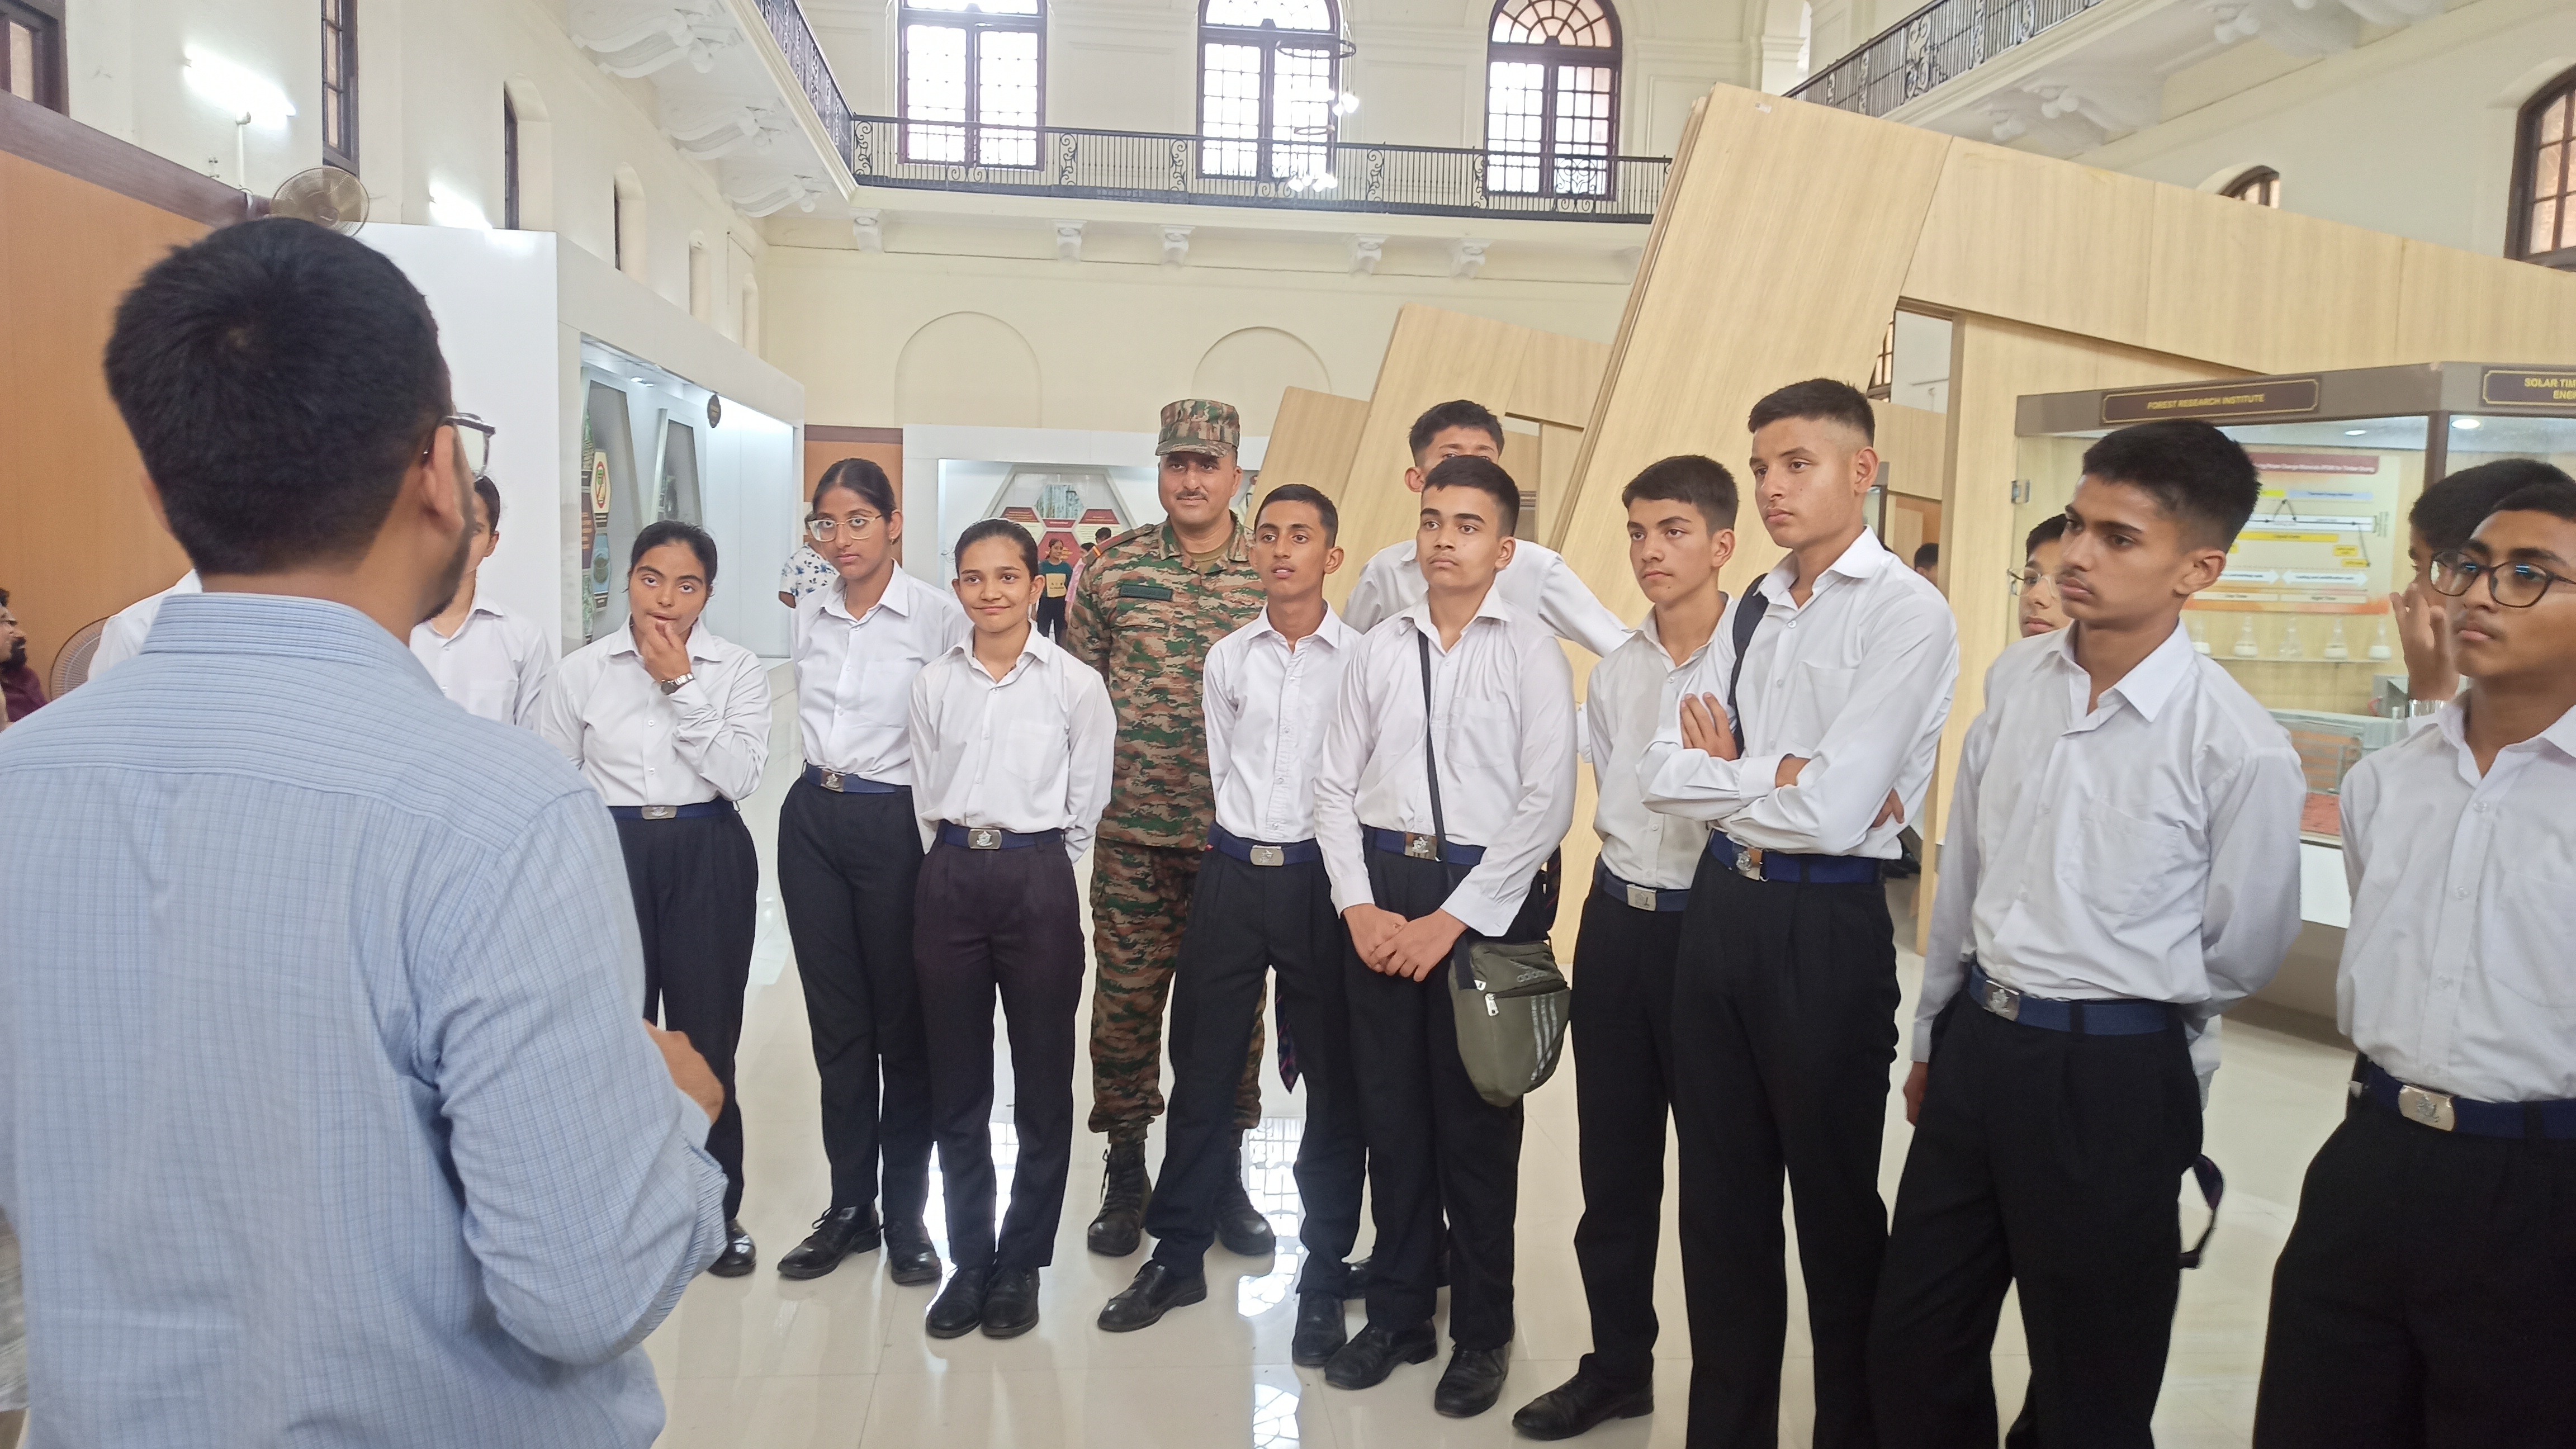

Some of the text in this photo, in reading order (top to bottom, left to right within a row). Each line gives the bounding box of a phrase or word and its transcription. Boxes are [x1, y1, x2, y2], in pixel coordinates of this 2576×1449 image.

[2525, 378, 2558, 387] SOLAR
[2147, 394, 2265, 410] FOREST RESEARCH INSTITUTE
